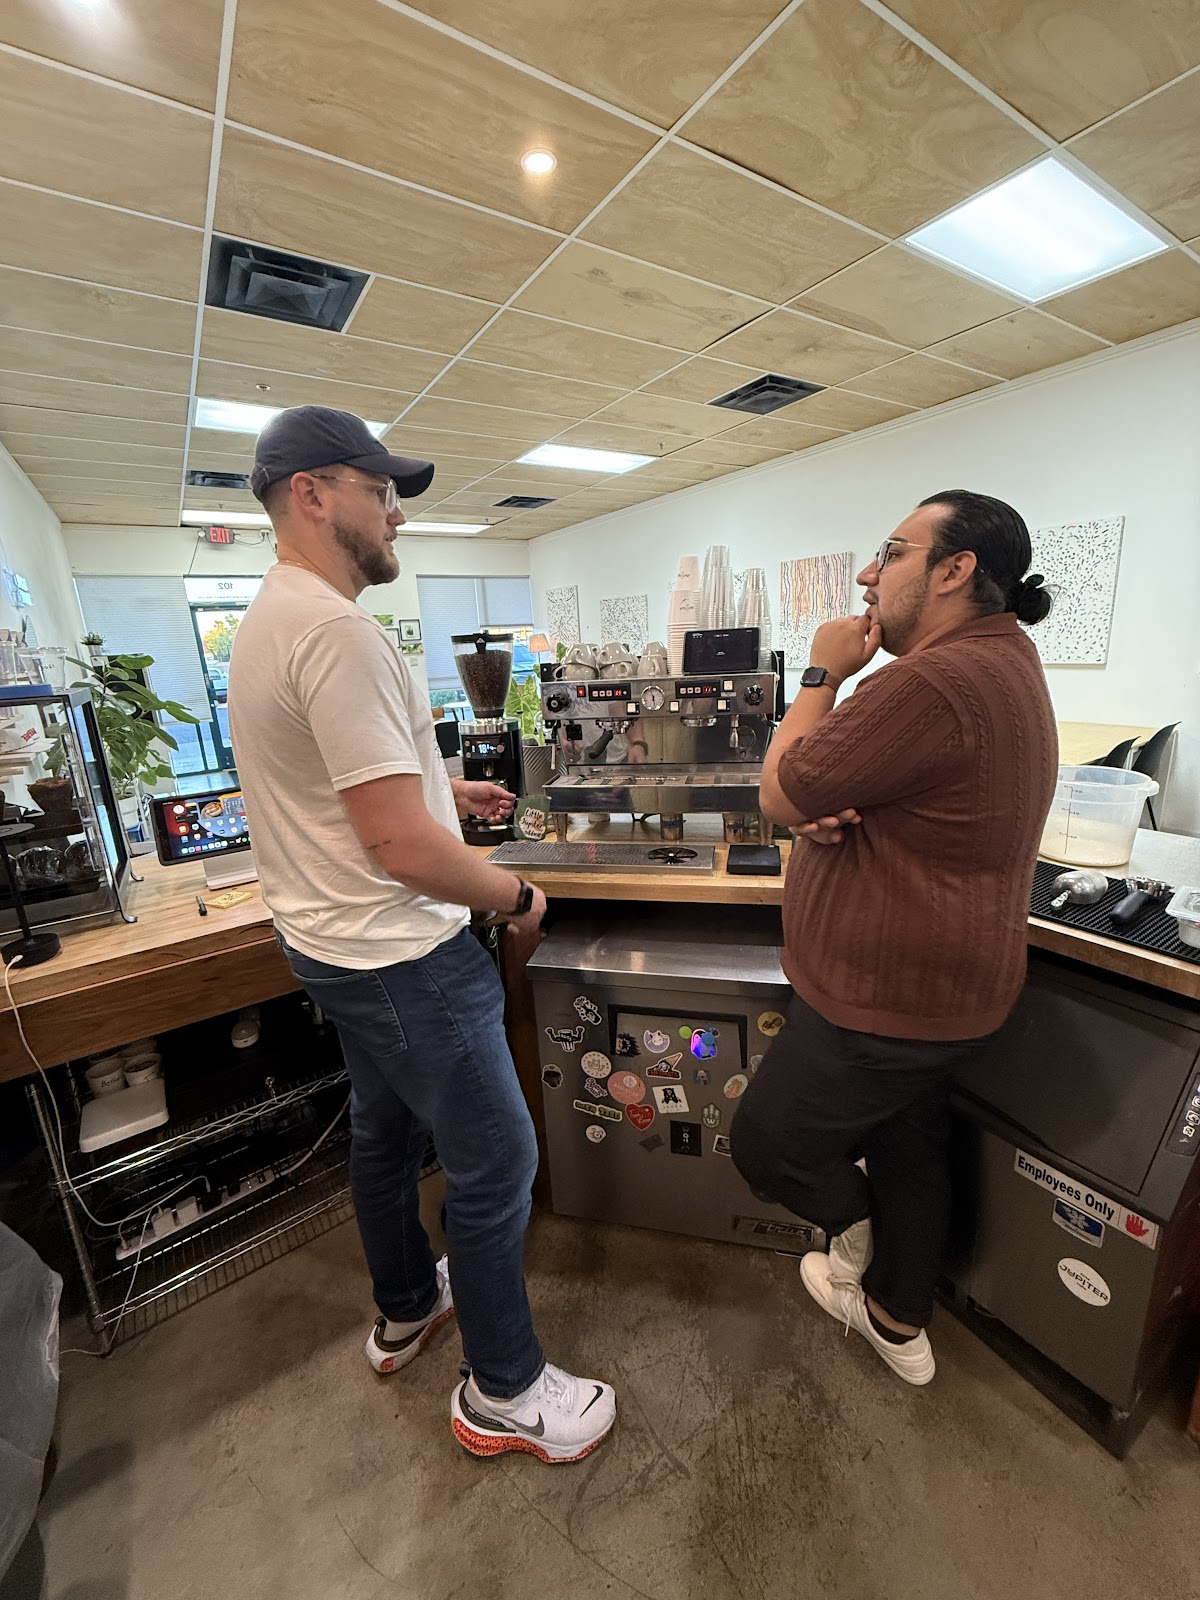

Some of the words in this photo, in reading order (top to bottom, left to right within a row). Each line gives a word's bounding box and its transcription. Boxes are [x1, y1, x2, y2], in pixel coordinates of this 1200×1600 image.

[209, 527, 230, 543] EXIT
[1017, 1155, 1081, 1201] Employees
[1085, 1193, 1115, 1220] Only
[1059, 1264, 1108, 1303] JUPITER
